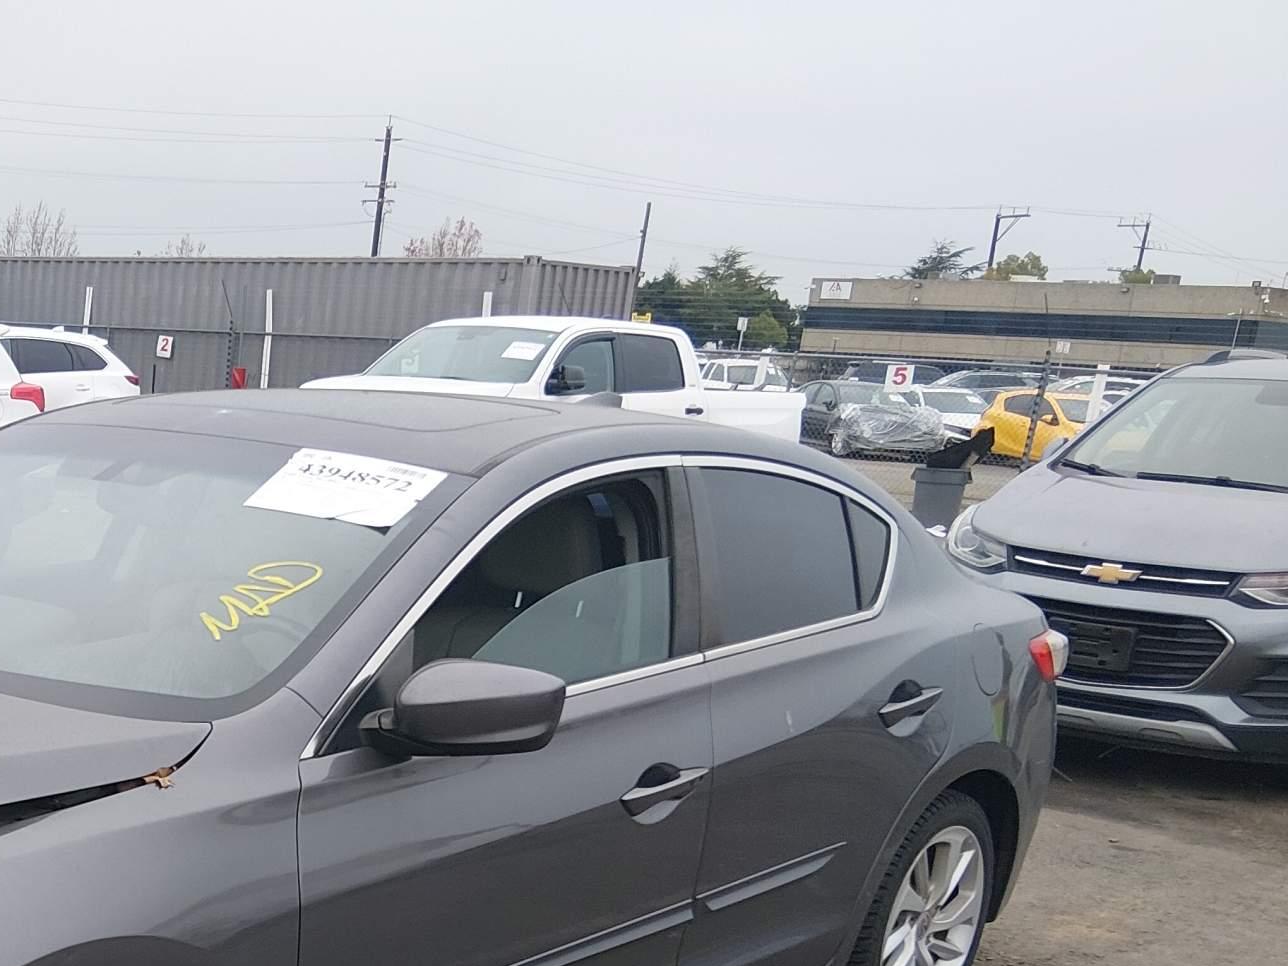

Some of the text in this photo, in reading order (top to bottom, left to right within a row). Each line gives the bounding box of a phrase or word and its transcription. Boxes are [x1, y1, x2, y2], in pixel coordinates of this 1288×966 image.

[159, 337, 169, 352] 2
[892, 366, 908, 385] 5
[298, 462, 413, 493] 43948572
